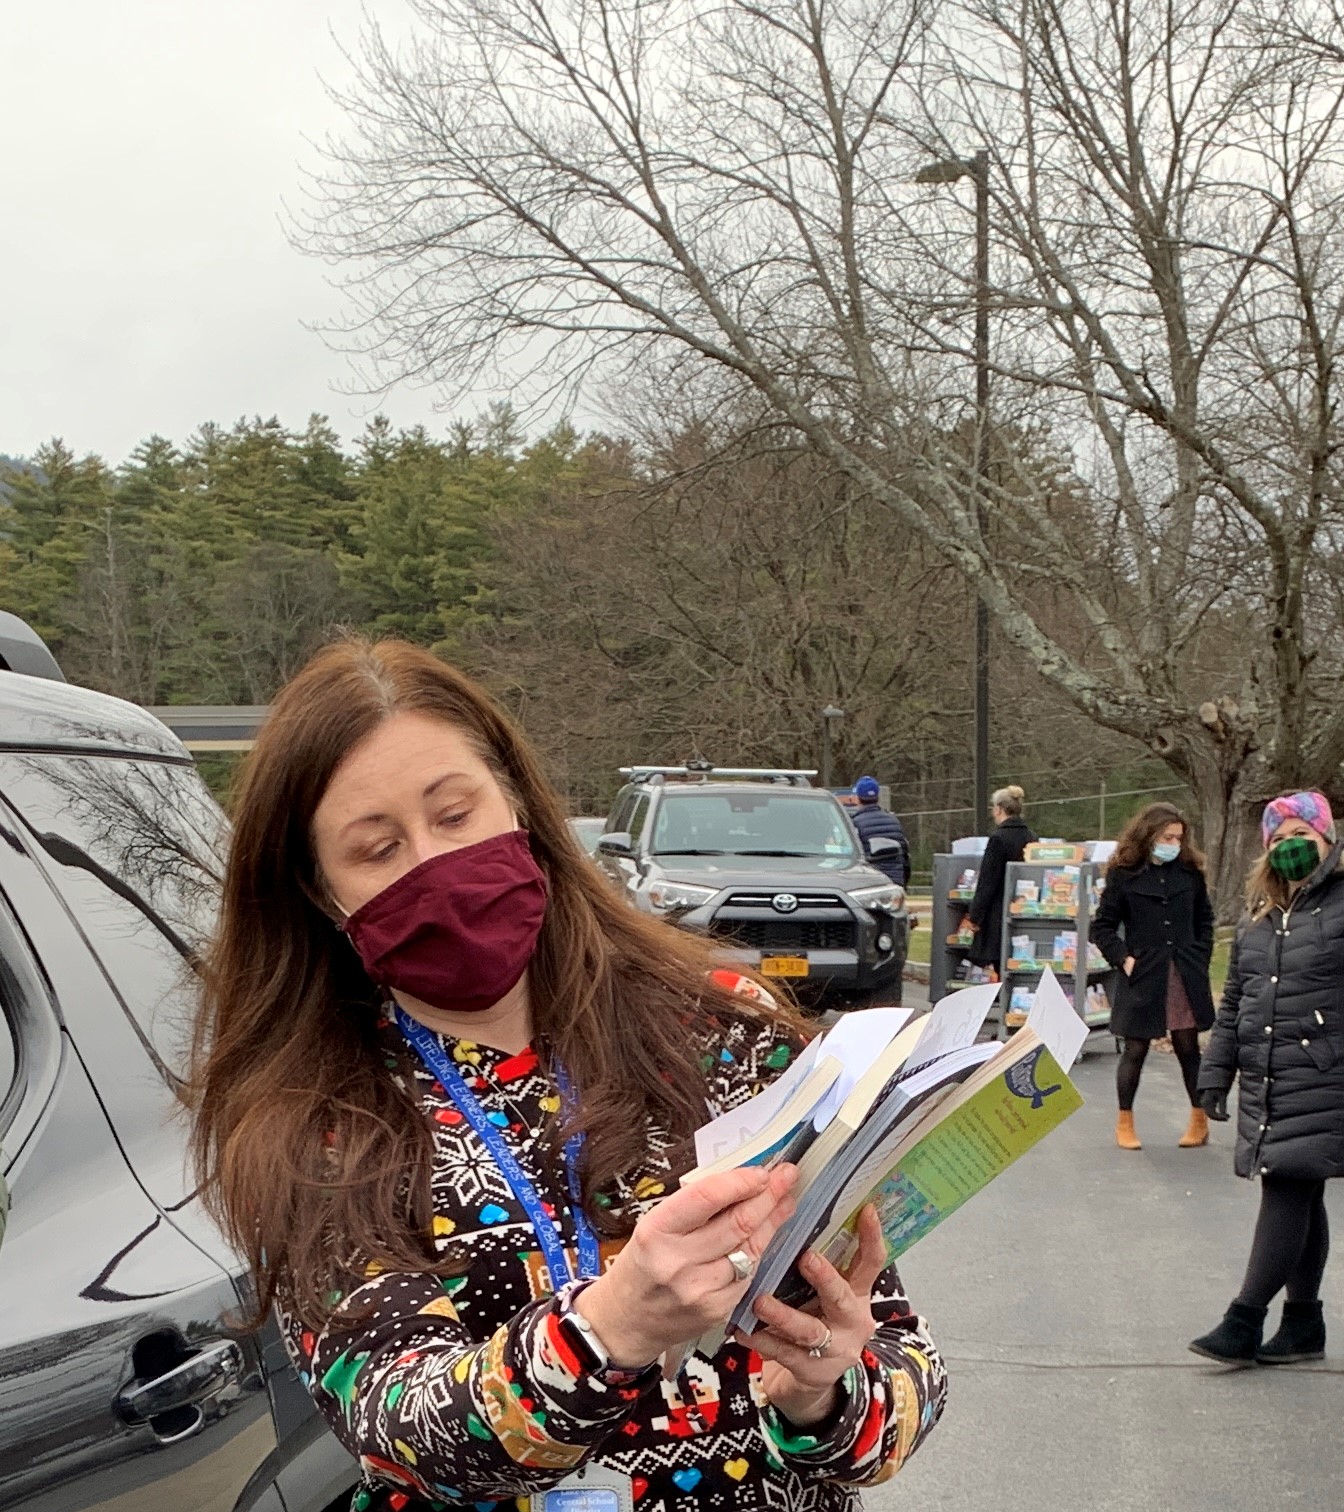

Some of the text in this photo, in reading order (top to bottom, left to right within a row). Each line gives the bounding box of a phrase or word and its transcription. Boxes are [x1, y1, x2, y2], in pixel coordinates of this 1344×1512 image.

[415, 1029, 455, 1081] LIFELONG
[487, 1135, 525, 1183] LEADERS
[518, 1186, 538, 1206] AND
[532, 1208, 560, 1257] GLOBAL
[589, 1496, 616, 1505] School
